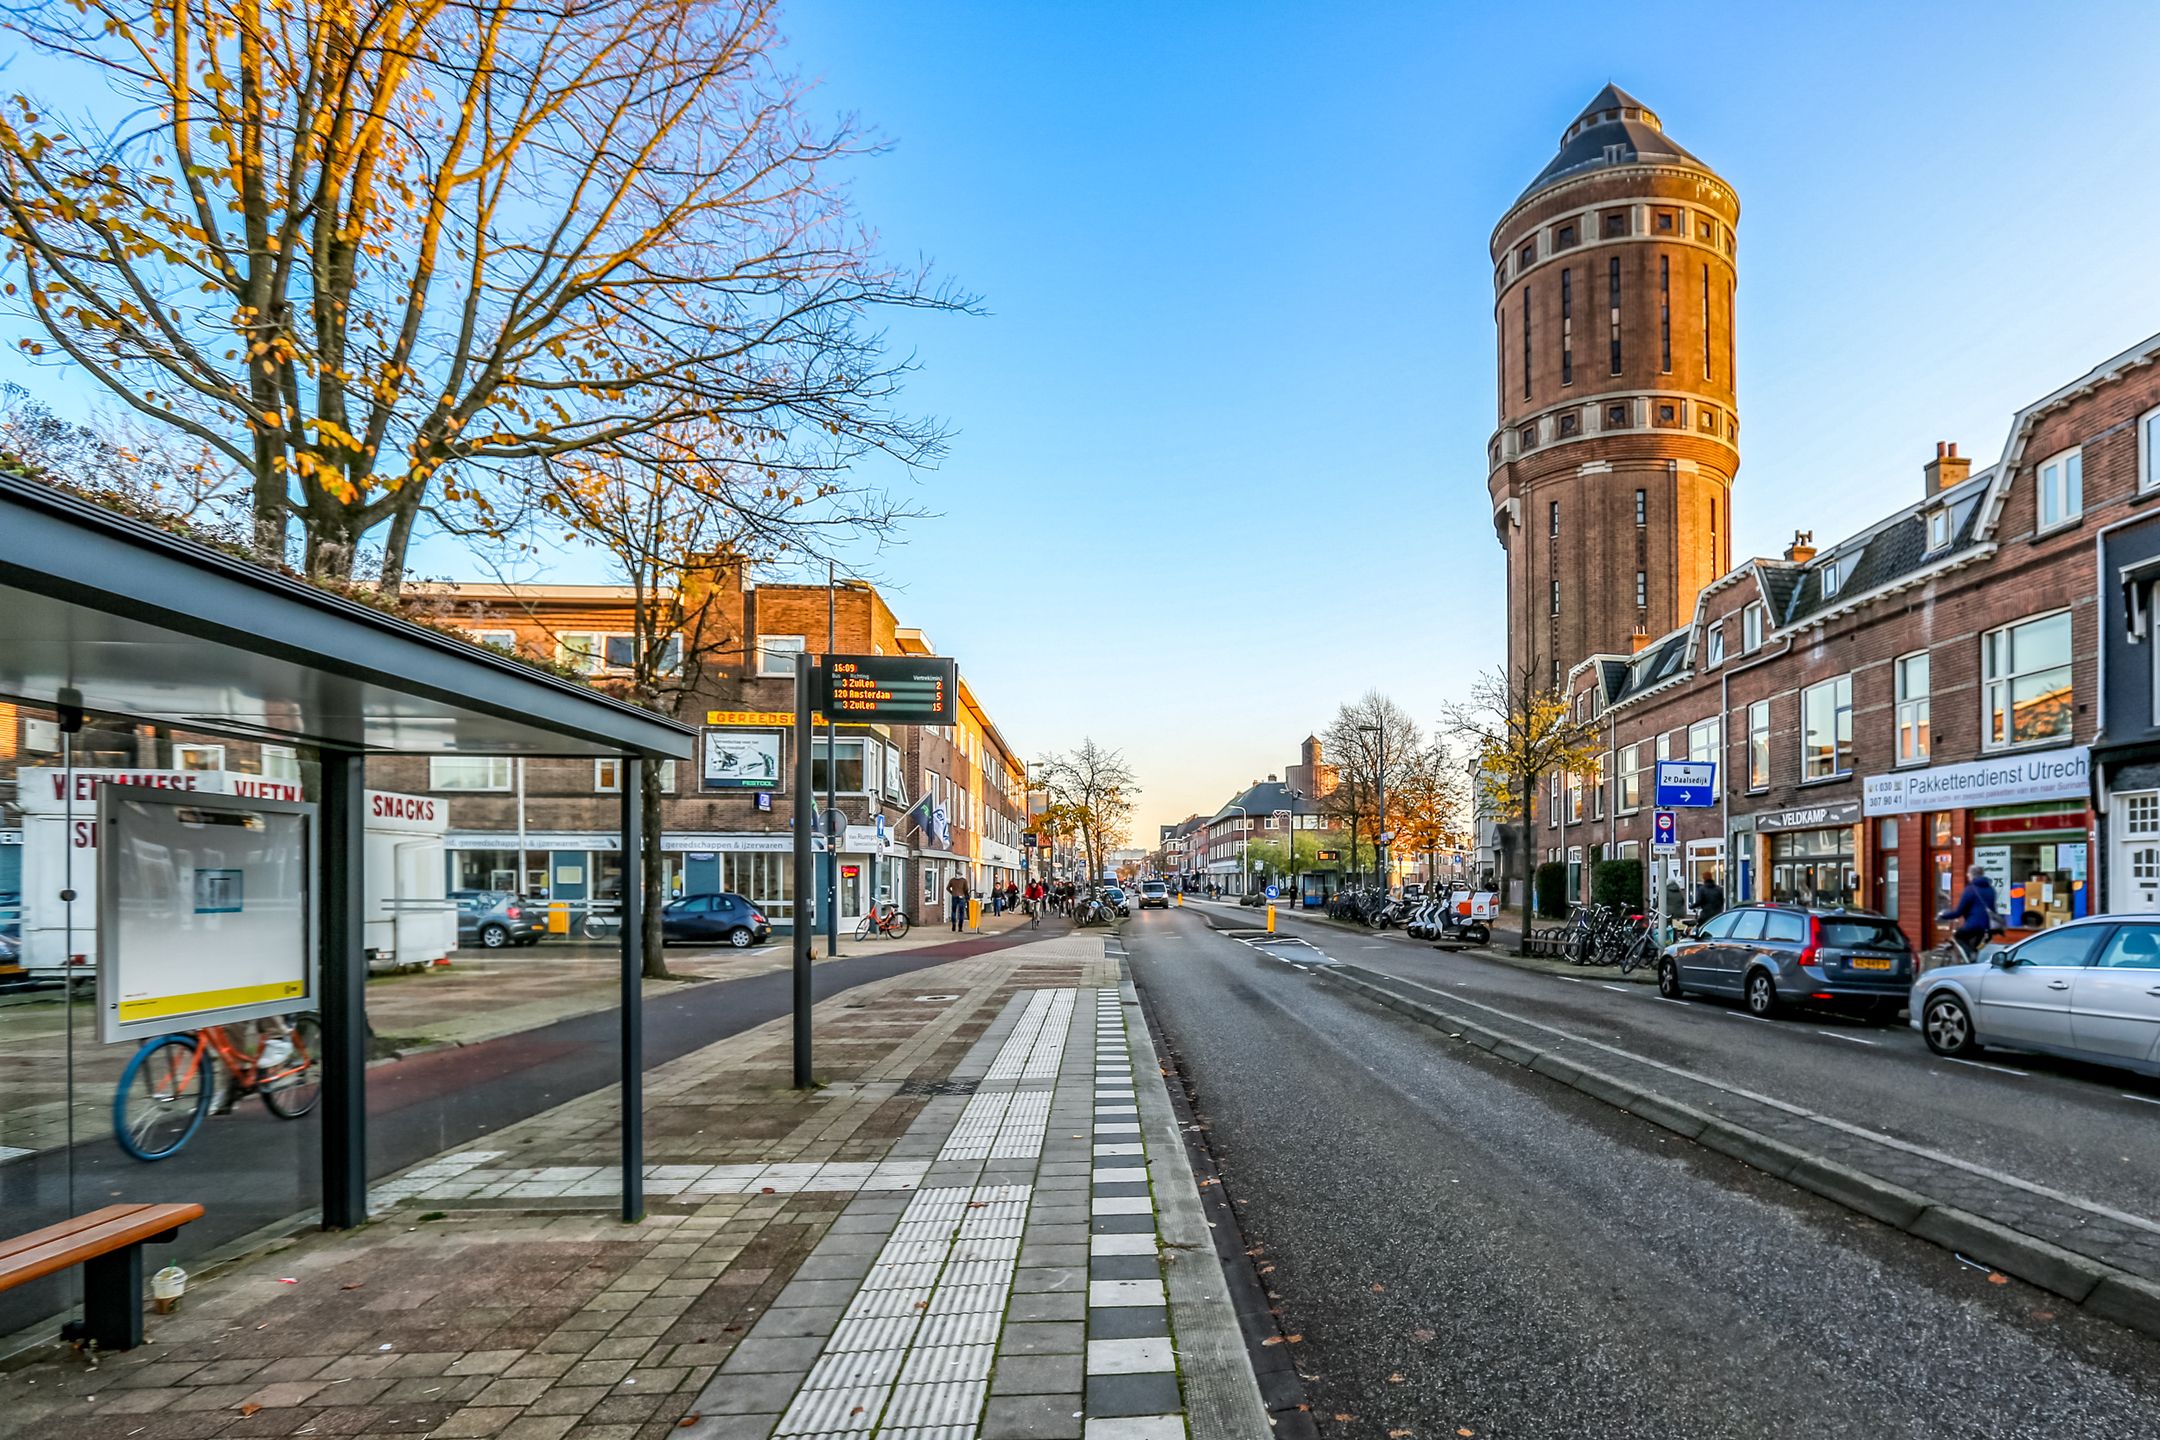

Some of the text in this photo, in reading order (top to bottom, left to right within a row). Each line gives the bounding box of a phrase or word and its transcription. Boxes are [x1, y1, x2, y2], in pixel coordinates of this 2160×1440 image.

[834, 664, 856, 672] 16:09
[842, 679, 942, 690] 3 Zuilen 2
[834, 690, 942, 701] 120 Amsterdam 5
[843, 701, 942, 711] 3 Zuilen 15
[1674, 776, 1707, 785] Daalsedijk
[1909, 756, 2088, 794] Pakkettendienst Utrech
[1880, 781, 1892, 791] 030
[1870, 797, 1881, 806] 307
[1894, 795, 1902, 803] 41
[373, 795, 434, 820] SNACKS
[1782, 808, 1828, 827] VELDKAMP
[665, 840, 732, 850] gereedschappen
[741, 840, 783, 850] ijzerwaren
